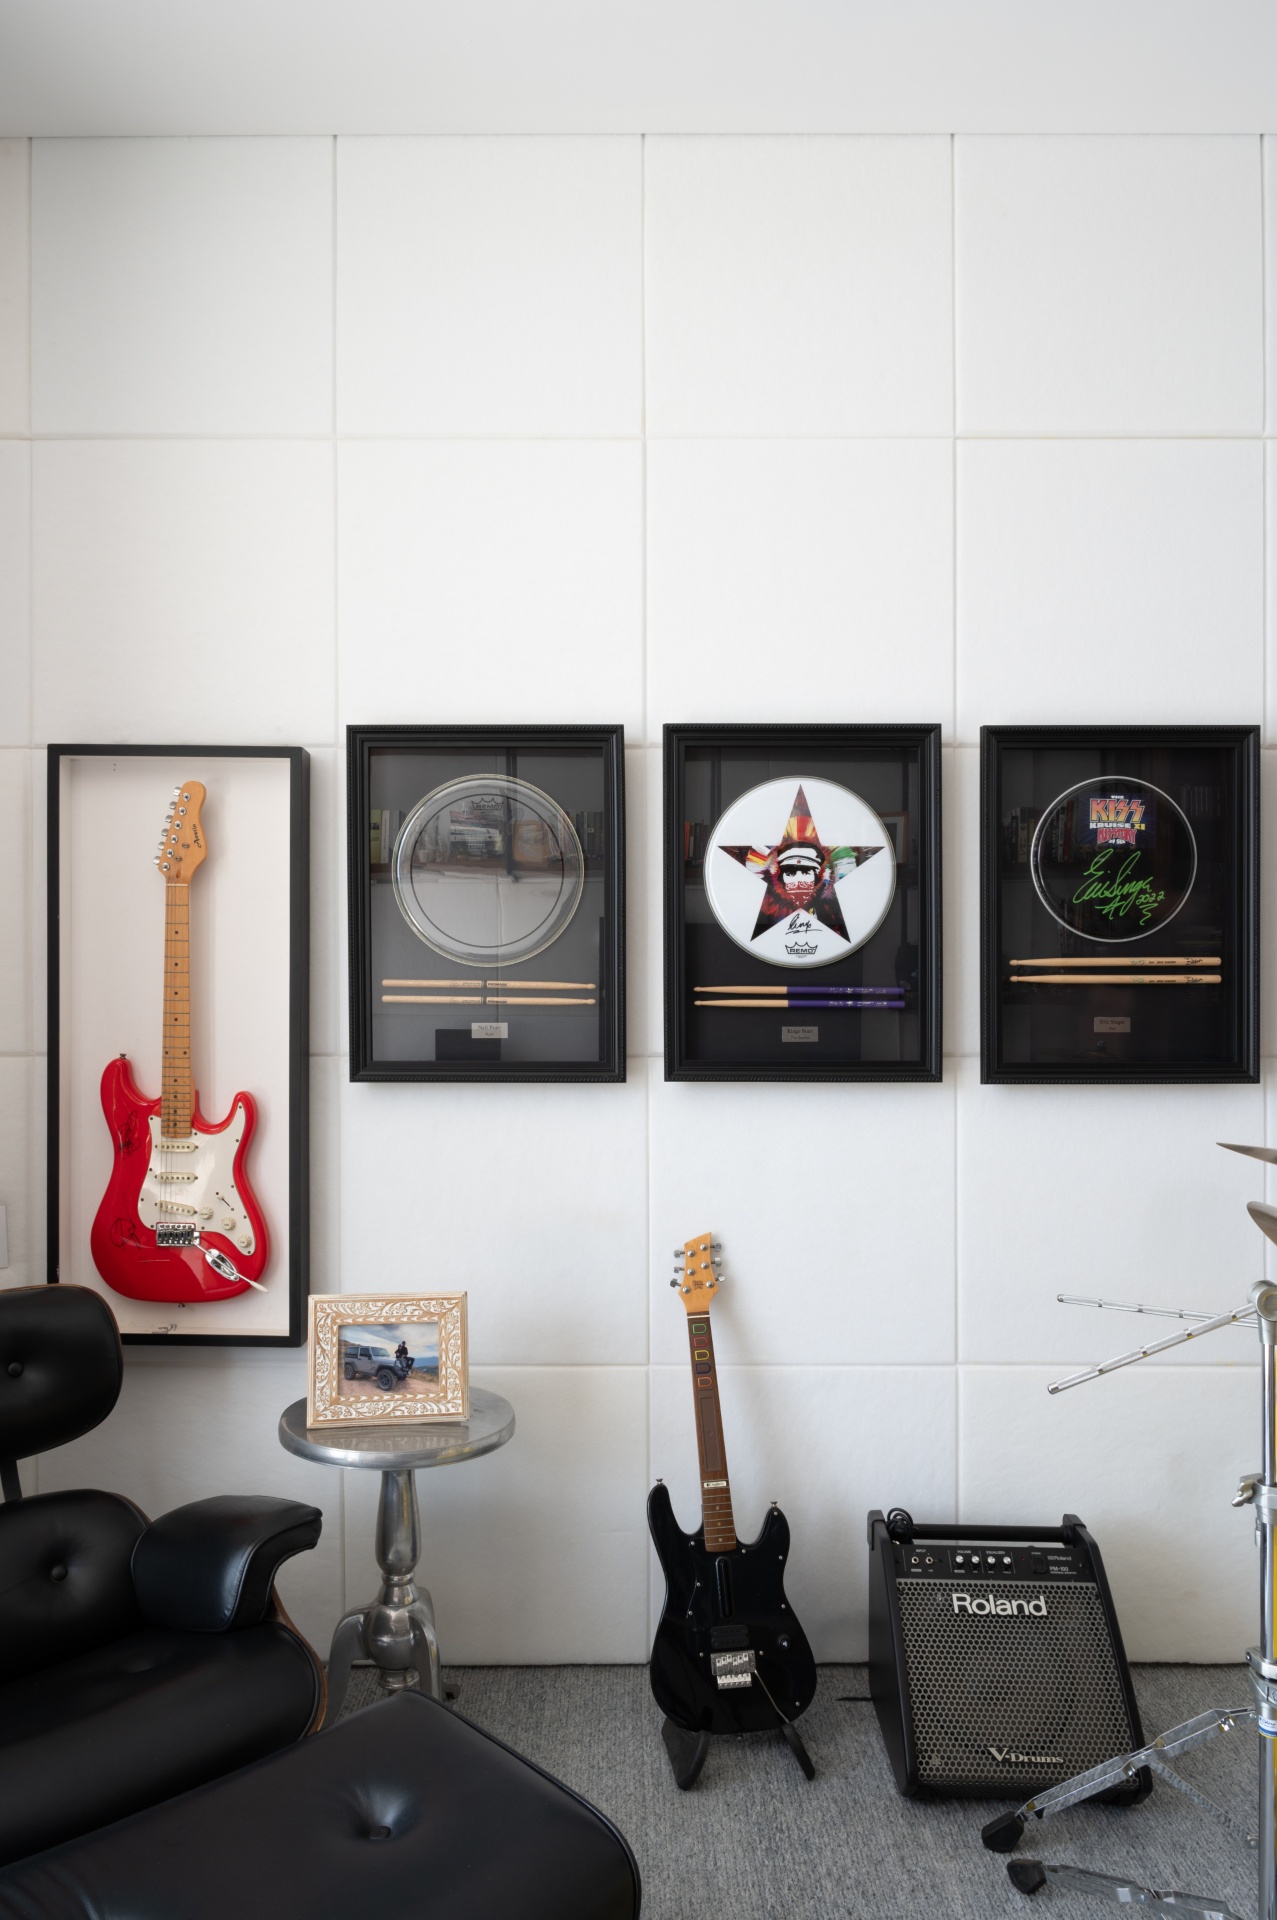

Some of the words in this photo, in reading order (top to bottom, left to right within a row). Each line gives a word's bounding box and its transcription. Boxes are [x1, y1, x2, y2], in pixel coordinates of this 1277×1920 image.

[1090, 798, 1145, 823] KISS
[1133, 823, 1146, 831] XI
[952, 1593, 1048, 1616] Roland
[987, 1747, 1064, 1763] V-Drums
